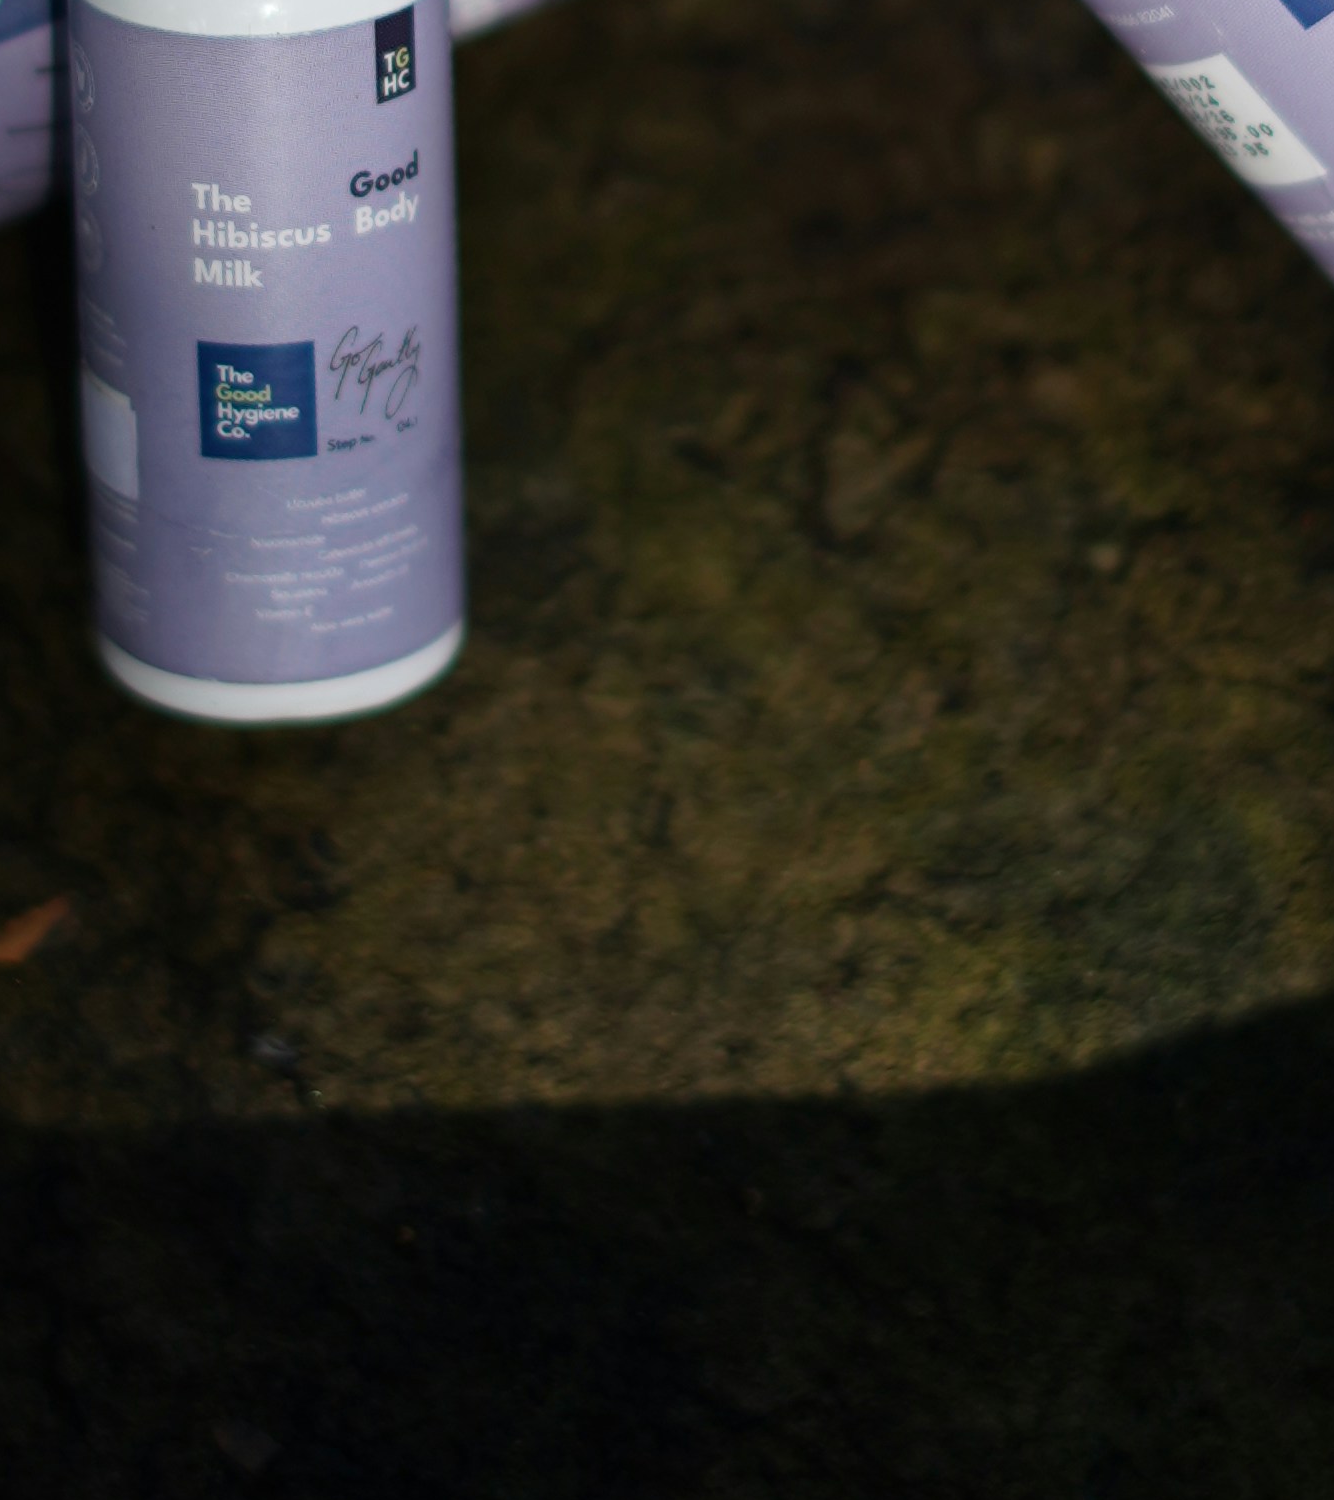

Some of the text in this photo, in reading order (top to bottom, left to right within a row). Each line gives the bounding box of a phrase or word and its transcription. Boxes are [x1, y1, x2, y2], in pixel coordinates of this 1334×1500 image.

[383, 47, 410, 73] TG
[383, 68, 410, 96] HC
[349, 148, 419, 198] Good
[191, 182, 252, 213] The
[354, 191, 419, 234] Body
[192, 218, 332, 248] Hibiscus
[194, 257, 264, 288] Milk
[217, 364, 254, 384] The
[216, 384, 272, 402] Good
[217, 402, 300, 425] Hygiene
[217, 421, 251, 439] Co.
